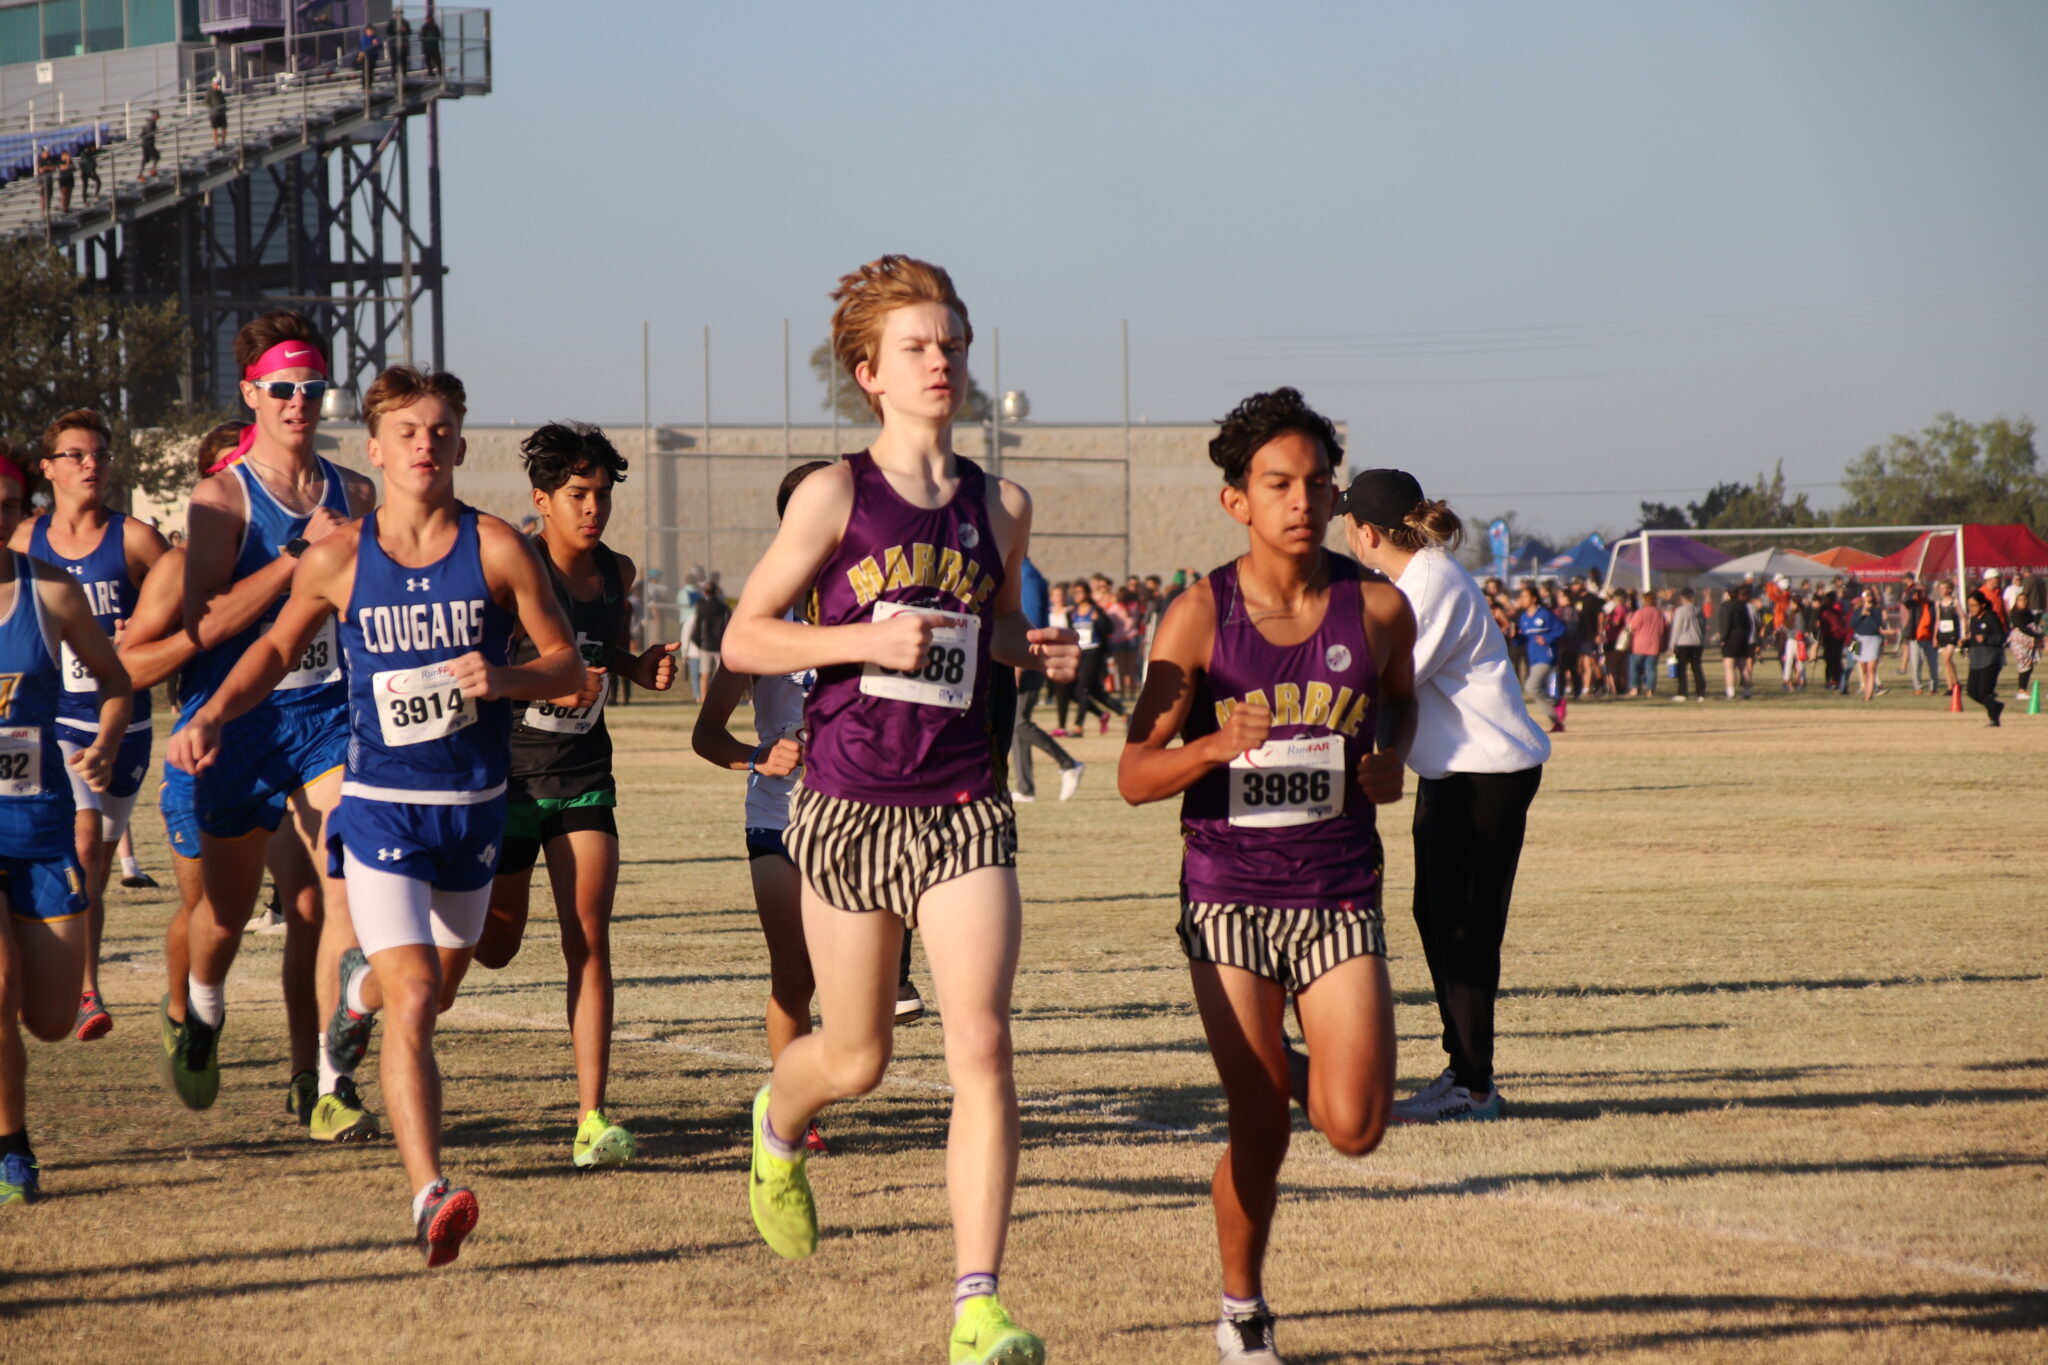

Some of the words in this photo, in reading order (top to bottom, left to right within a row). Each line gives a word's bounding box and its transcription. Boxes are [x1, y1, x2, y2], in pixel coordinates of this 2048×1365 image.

[846, 542, 995, 614] MARBLE
[359, 600, 485, 653] COUGARS
[390, 688, 464, 727] 3914
[1243, 770, 1330, 806] 3986
